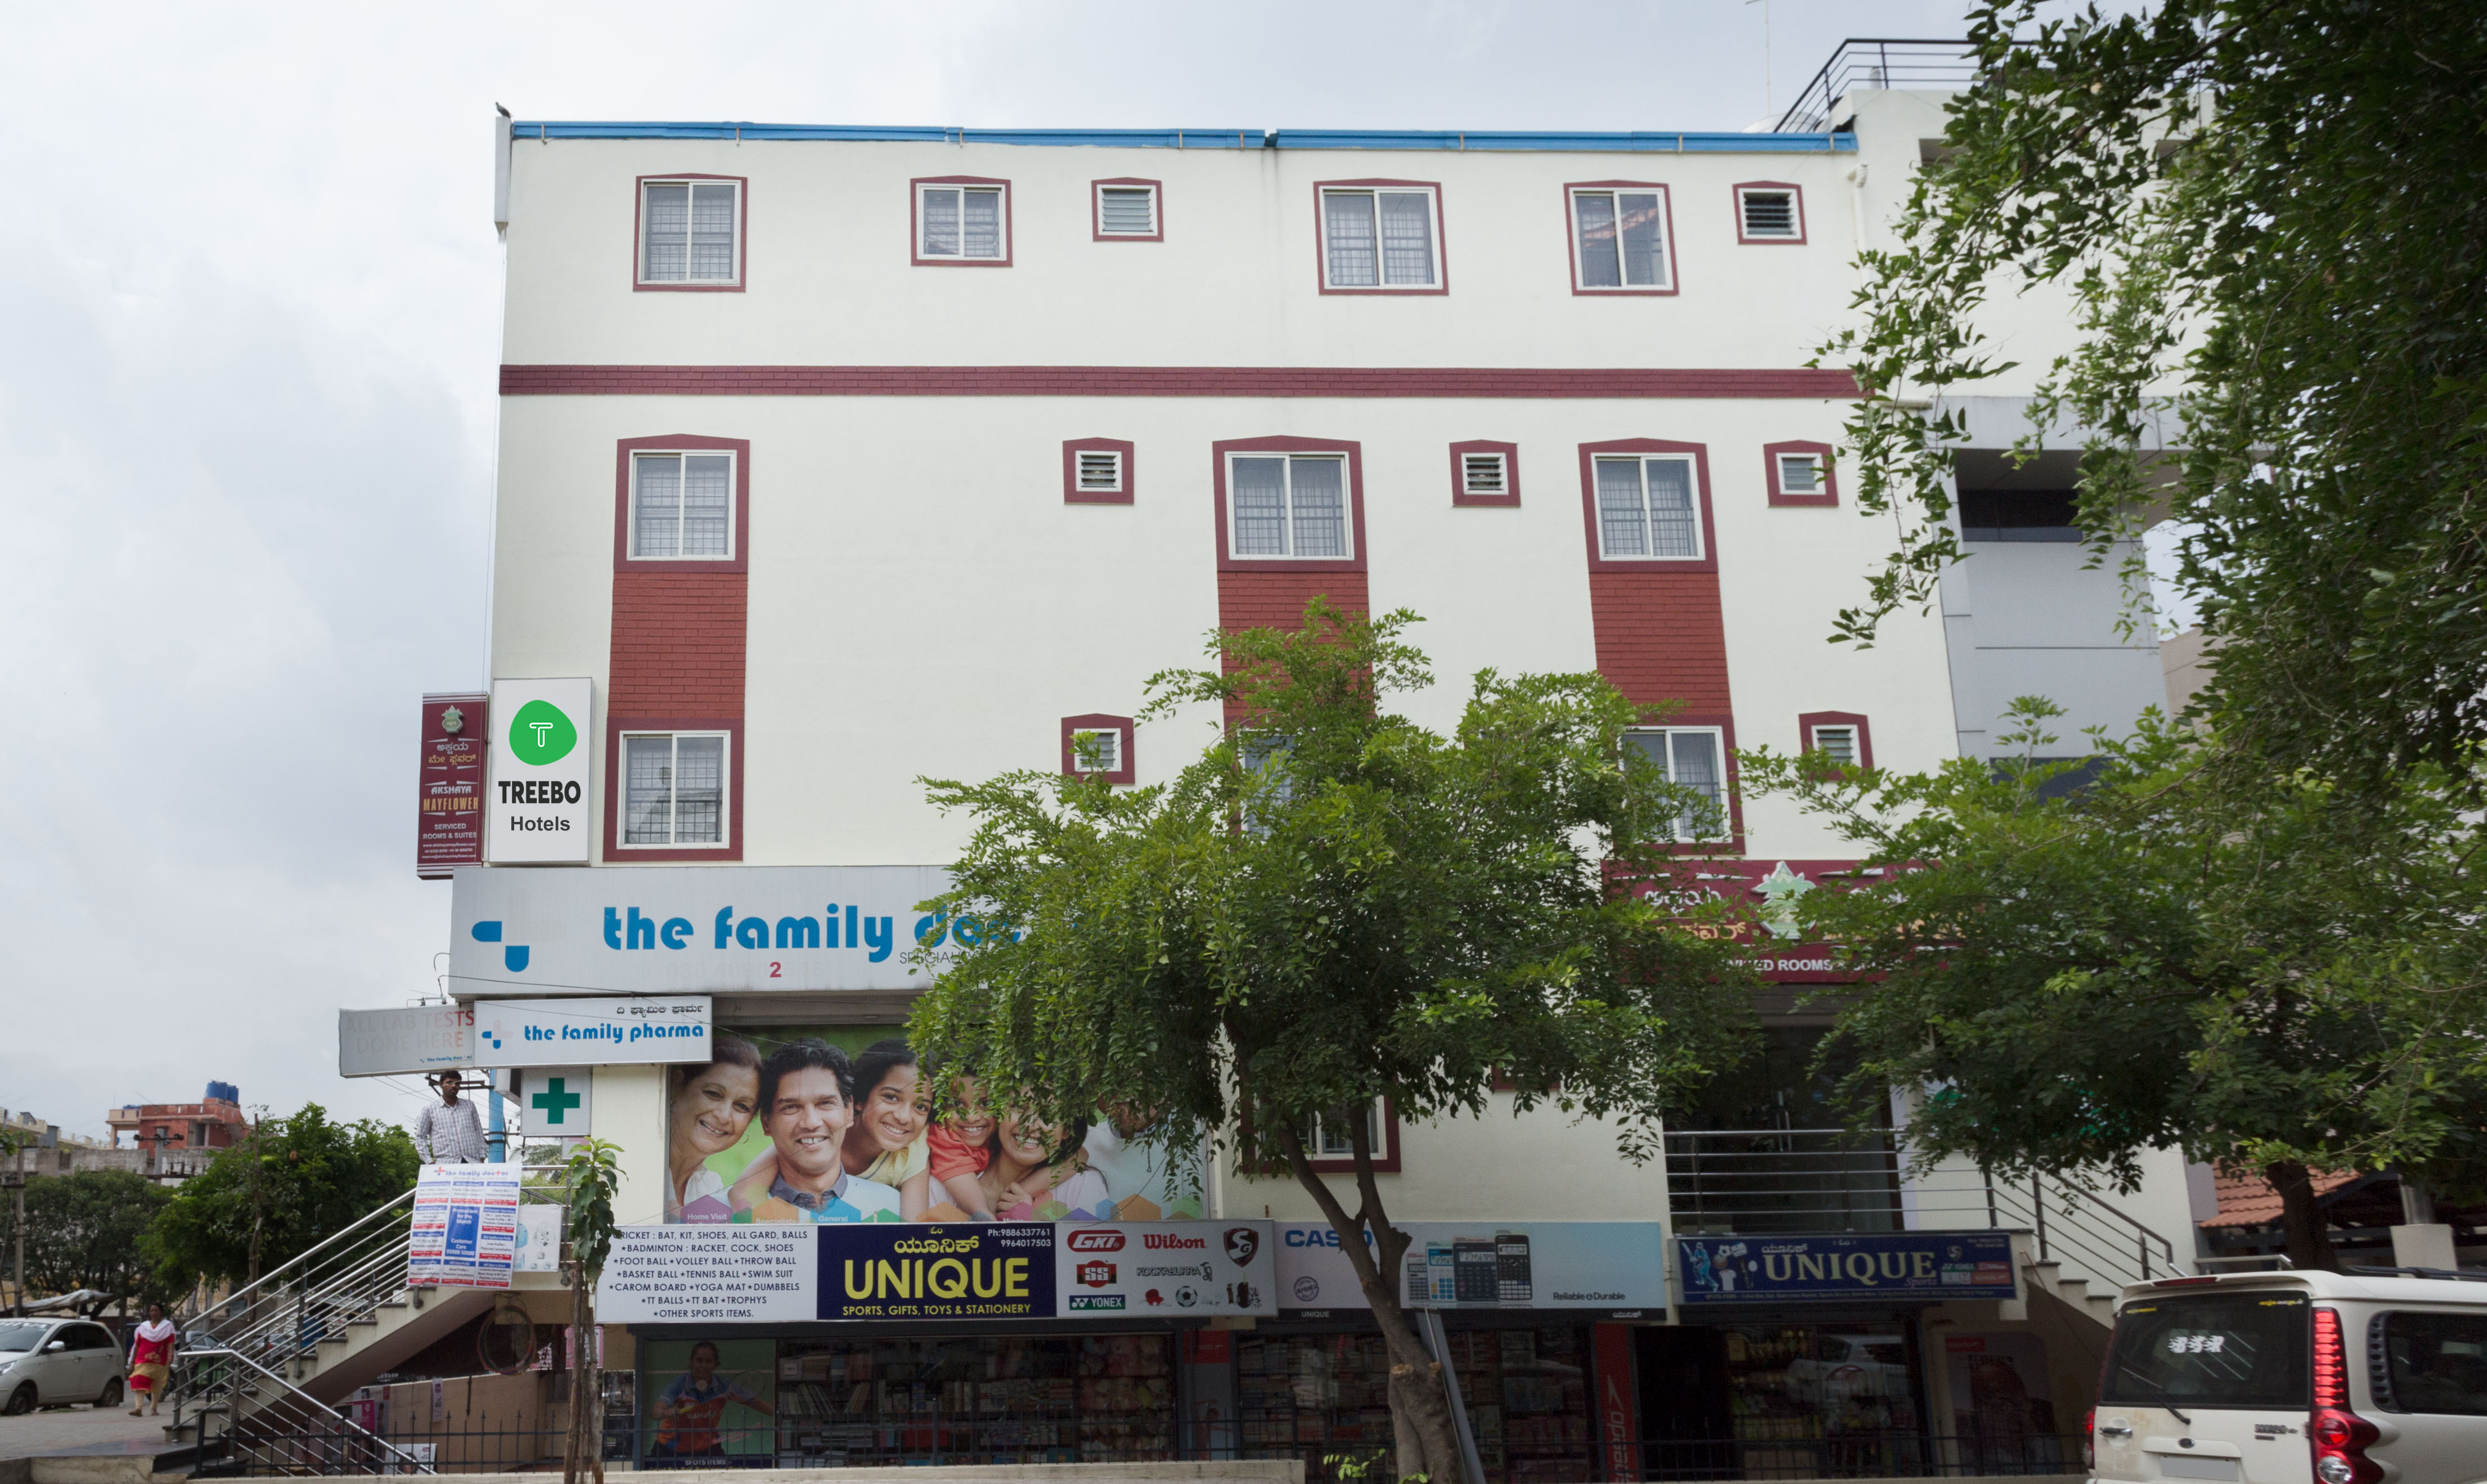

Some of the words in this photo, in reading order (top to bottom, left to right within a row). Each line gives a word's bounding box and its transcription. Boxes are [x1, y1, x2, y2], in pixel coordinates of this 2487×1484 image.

[431, 785, 471, 795] AKSHAYA
[498, 781, 581, 804] TREEBO
[423, 797, 478, 811] MAYFLOWER
[511, 816, 570, 831] Hotels
[604, 906, 694, 950] the
[714, 903, 893, 963] family
[770, 962, 782, 978] 2
[1778, 960, 1833, 971] ROOMS
[422, 1010, 475, 1028] TESTS
[417, 1031, 464, 1050] HERE
[524, 1026, 560, 1042] the
[562, 1023, 623, 1044] family
[630, 1023, 703, 1042] pharma
[698, 1231, 728, 1240] SHOES,
[988, 1229, 1050, 1237] Ph:9886337761
[1285, 1230, 1373, 1247] CASO
[894, 1235, 979, 1253] ಯೂನಿಕ್
[1072, 1234, 1123, 1249] GKI
[1143, 1234, 1205, 1249] Wilson
[1085, 1267, 1109, 1281] SS
[1136, 1266, 1202, 1277] KOOKABURRA
[1762, 1251, 1937, 1286] UNIQUE
[845, 1257, 1029, 1299] UNIQUE
[1904, 1278, 1938, 1288] Sports
[1091, 1297, 1122, 1308] YONEX
[1553, 1292, 1585, 1300] Reliable
[1594, 1291, 1625, 1300] Durable
[843, 1306, 885, 1316] SPORTS,
[889, 1305, 920, 1315] GIFTS,
[924, 1305, 952, 1315] TOYS
[955, 1305, 963, 1314] &
[966, 1304, 1031, 1314] STATIONERY
